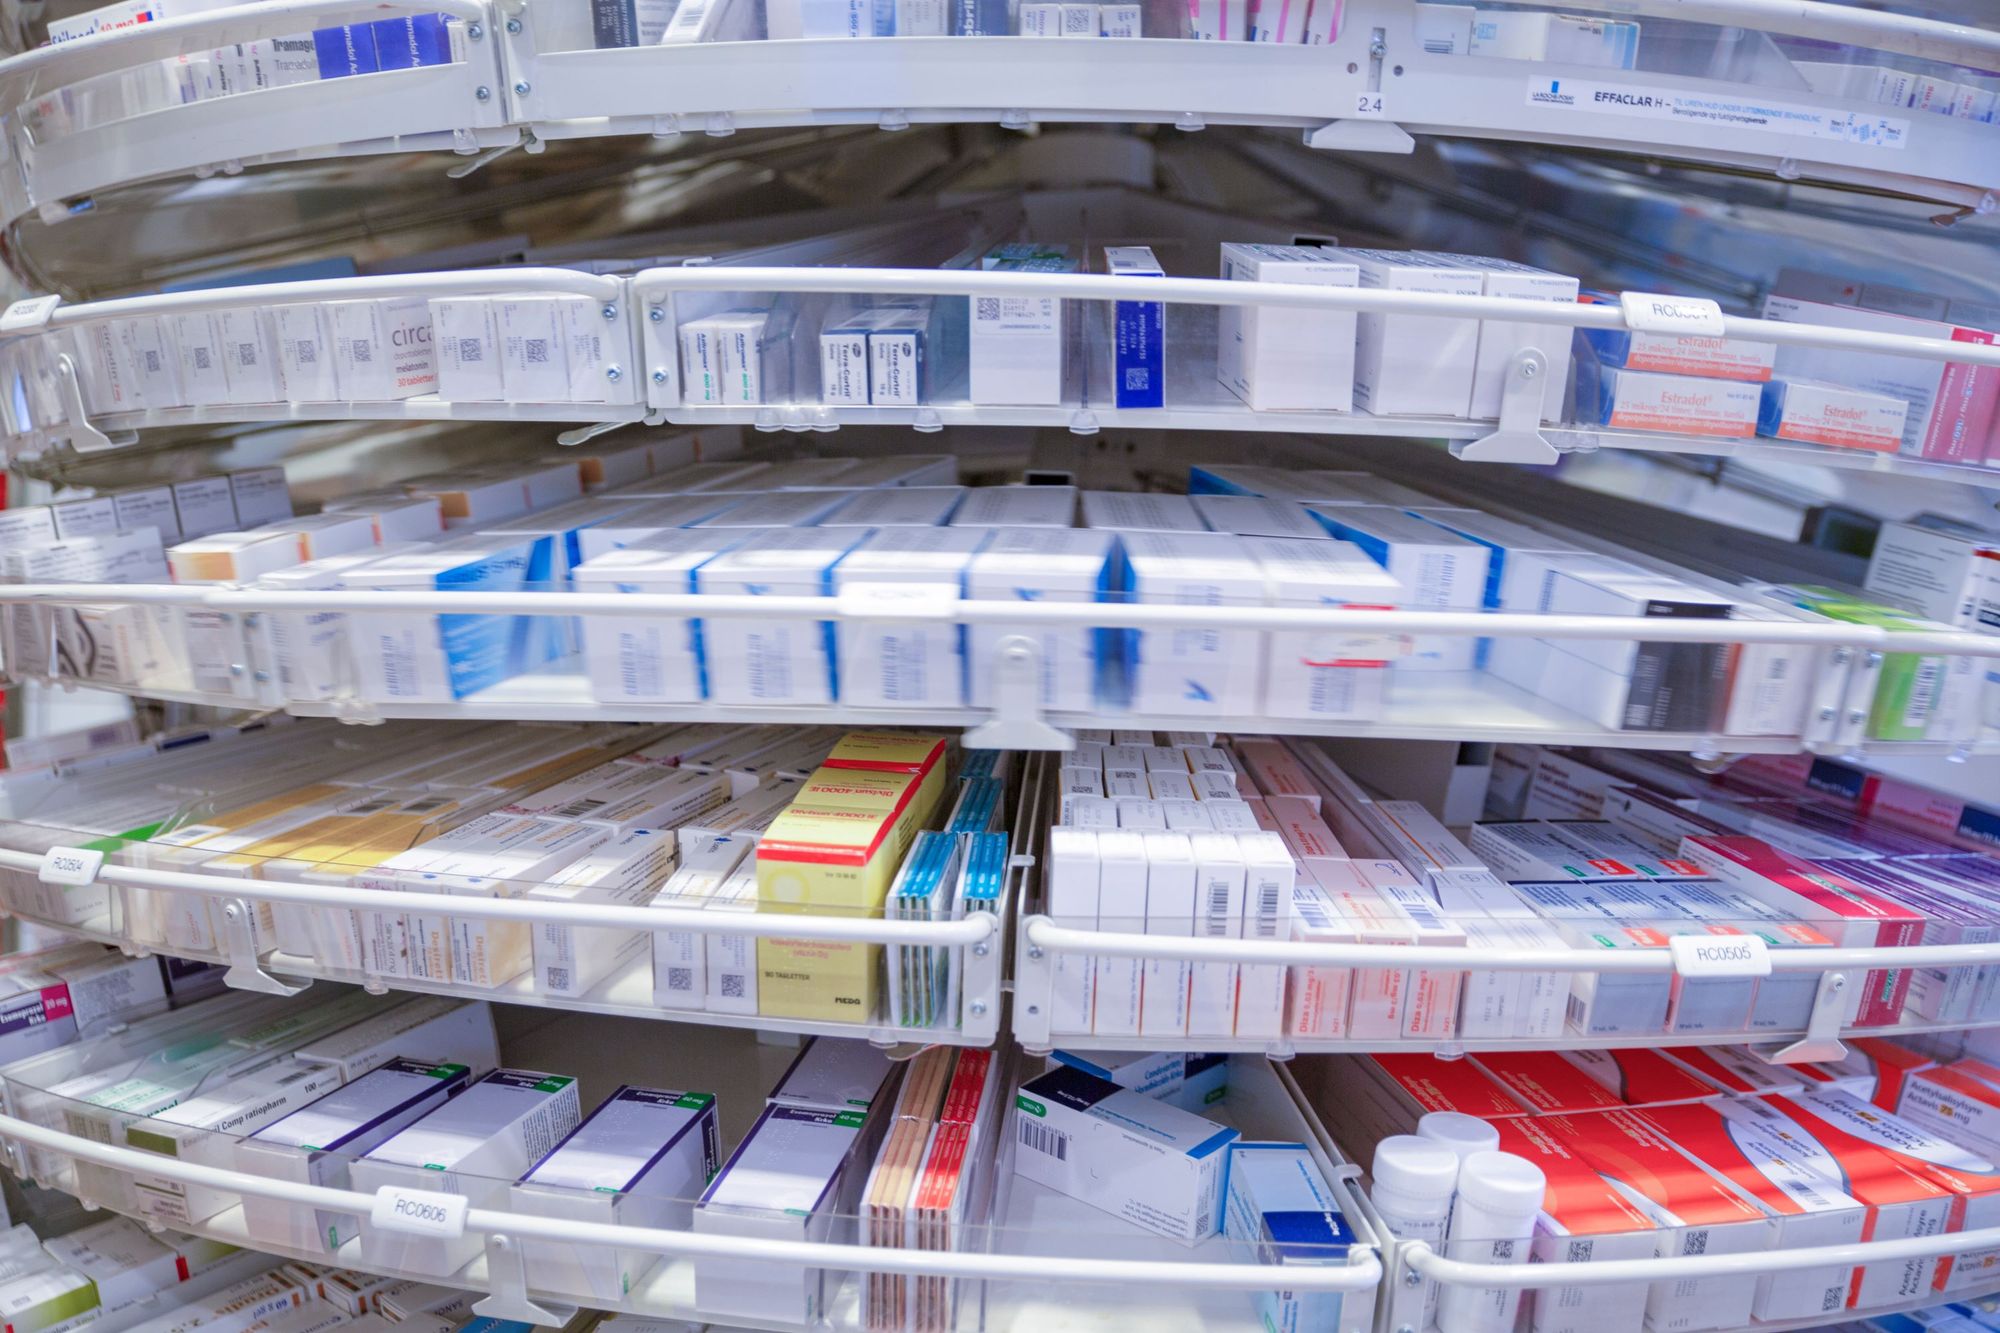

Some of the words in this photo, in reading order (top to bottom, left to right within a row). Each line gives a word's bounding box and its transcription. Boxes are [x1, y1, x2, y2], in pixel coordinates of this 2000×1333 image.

[1359, 97, 1382, 112] 2.4
[1594, 91, 1652, 107] EFFACLAR
[1655, 98, 1663, 108] H
[1678, 336, 1723, 350] Estradot
[395, 361, 429, 373] melatonin
[1661, 391, 1708, 405] Estradot
[1824, 405, 1864, 420] Estradot
[821, 786, 853, 795] 4000
[853, 787, 895, 797] Divisun
[431, 931, 443, 980] Desirett
[475, 935, 487, 985] Desirett
[1697, 945, 1752, 962] RC0505
[1299, 1009, 1310, 1032] Diza
[1411, 1009, 1422, 1032] Diza
[304, 1082, 317, 1094] 100
[1833, 1099, 1858, 1114] mg
[1911, 1081, 1983, 1115] Acetylsalisylsyre
[222, 1115, 244, 1131] Comp
[245, 1096, 287, 1120] ratiopharm
[790, 1109, 836, 1118] Esomeprazol
[1908, 1092, 1938, 1110] Actavis
[1940, 1104, 1953, 1116] 75
[1954, 1112, 1970, 1125] mg
[1808, 1095, 1916, 1152] Acetylsalisylsyre
[1856, 1111, 1881, 1125] 75
[1880, 1120, 1930, 1148] Actavis
[395, 1198, 447, 1223] RC0606
